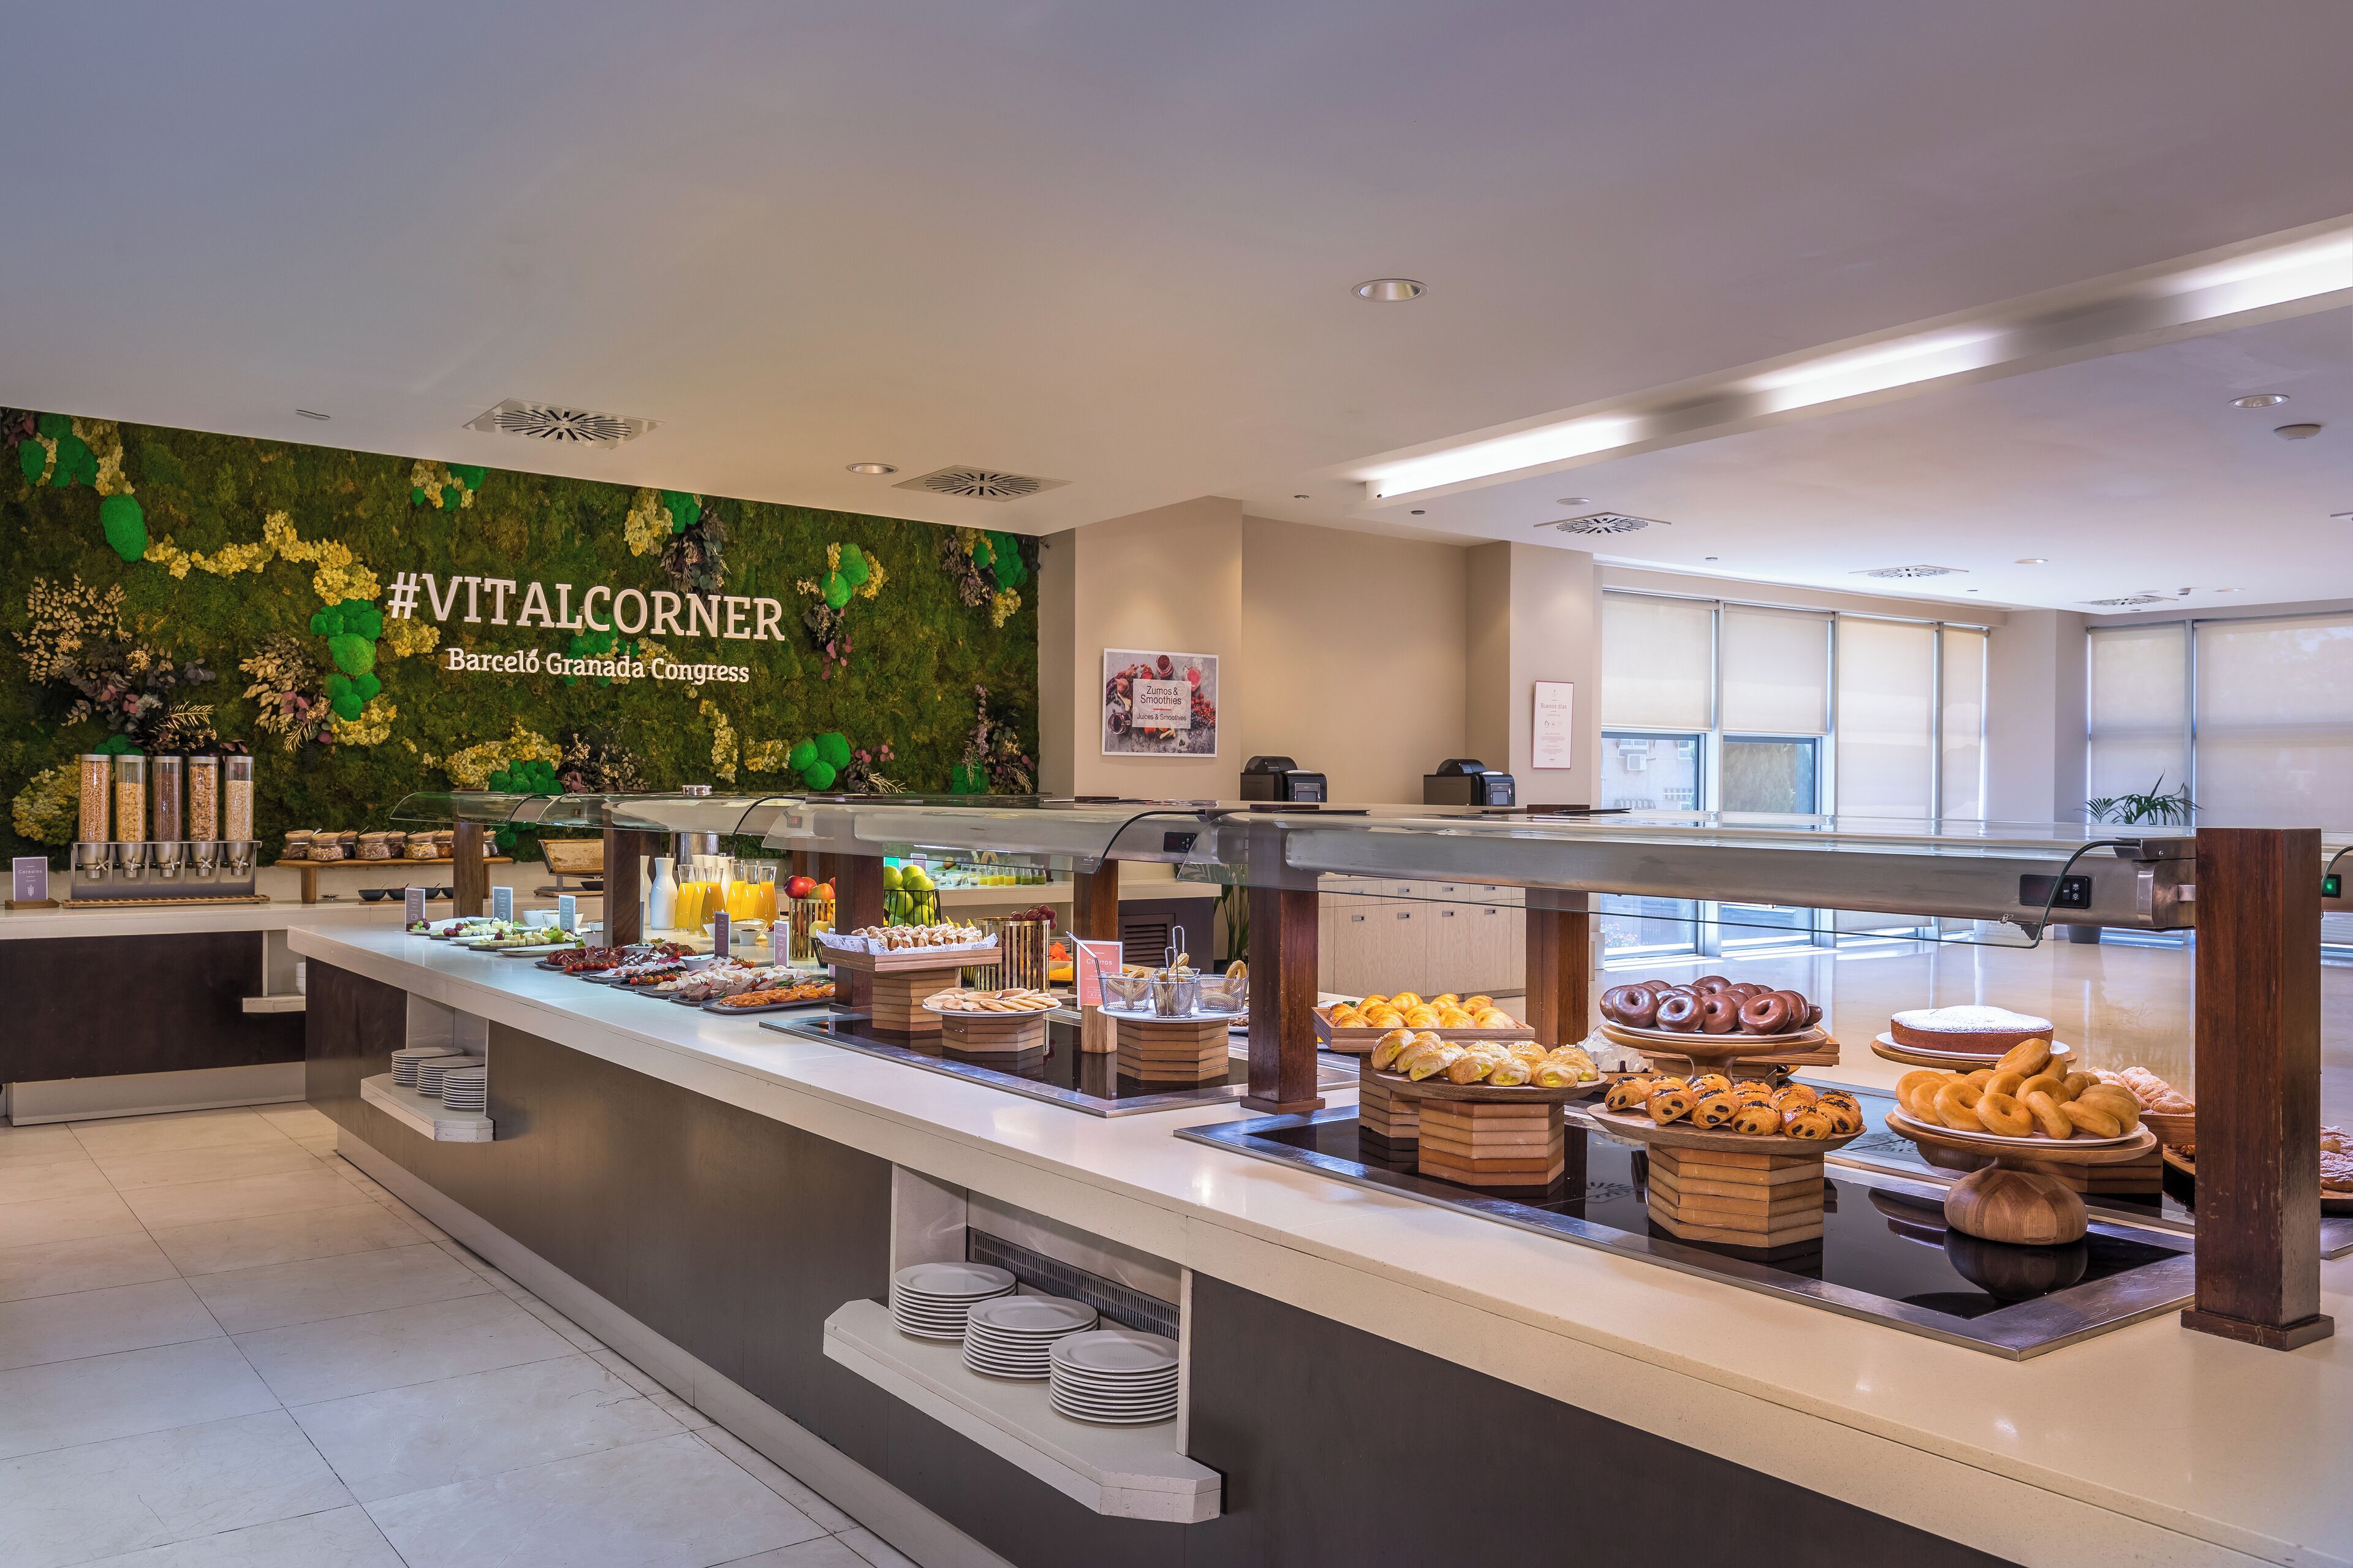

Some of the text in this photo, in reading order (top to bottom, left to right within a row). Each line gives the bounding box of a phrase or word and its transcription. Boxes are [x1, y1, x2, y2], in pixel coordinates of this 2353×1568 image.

[387, 571, 785, 642] #VITALCORNER
[446, 646, 749, 686] Barceló Granada Congress
[1140, 694, 1181, 705] Smoothies
[1146, 686, 1178, 696] Zumos &
